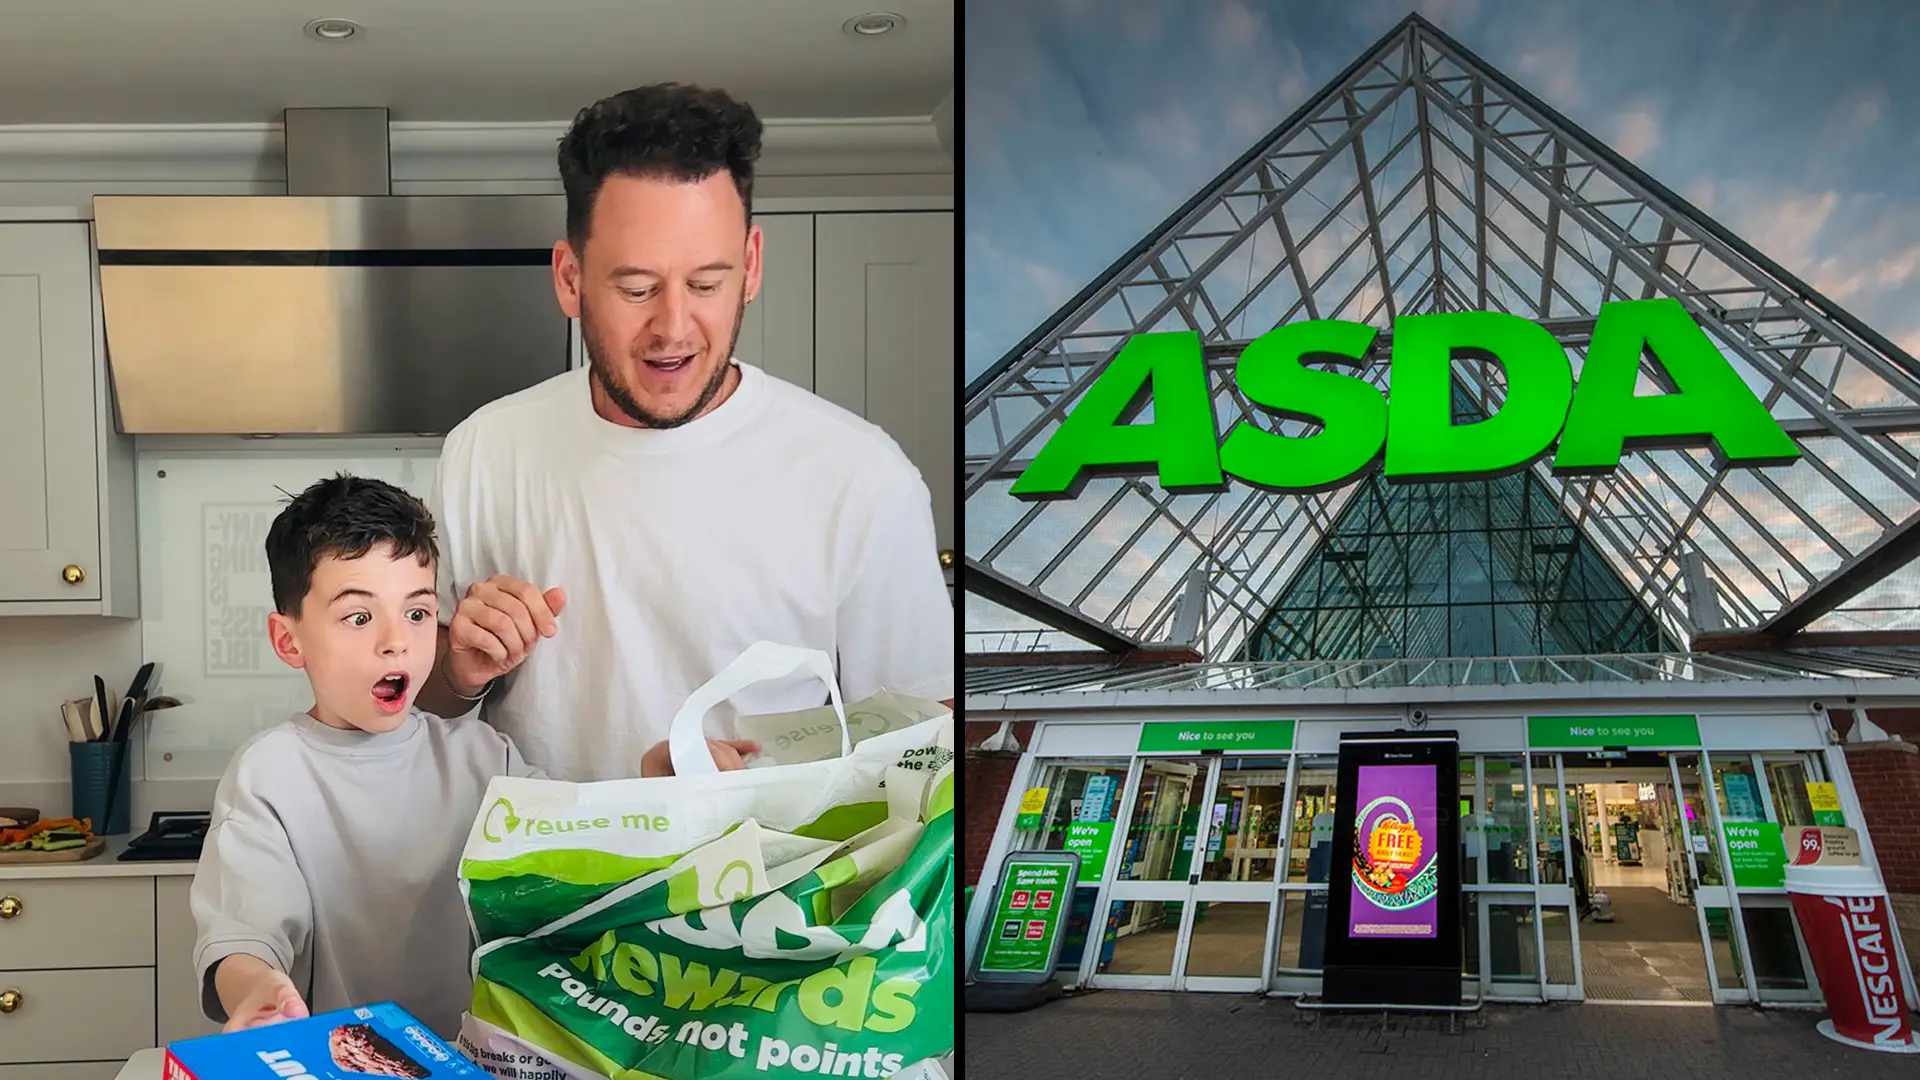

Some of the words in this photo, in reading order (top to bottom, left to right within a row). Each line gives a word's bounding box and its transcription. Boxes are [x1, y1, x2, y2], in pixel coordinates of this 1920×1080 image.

[1009, 297, 1800, 501] ASDA
[1178, 731, 1200, 741] Nice
[1203, 731, 1213, 740] to
[1216, 732, 1233, 740] see
[1235, 731, 1255, 742] you
[1570, 727, 1595, 736] Nice
[1597, 727, 1609, 736] to
[1612, 727, 1631, 736] see
[1634, 727, 1655, 737] you
[525, 817, 610, 836] reuse
[621, 814, 670, 832] me
[1071, 826, 1099, 835] We're
[1726, 827, 1759, 837] We're
[1068, 839, 1092, 848] open
[1378, 832, 1414, 849] FREE
[1730, 841, 1758, 850] open
[537, 962, 670, 1044] Pounds
[675, 1020, 749, 1058] not
[756, 1036, 904, 1079] points
[480, 1048, 515, 1063] breaks
[519, 1055, 533, 1064] or
[483, 1063, 497, 1074] we
[499, 1066, 516, 1078] will
